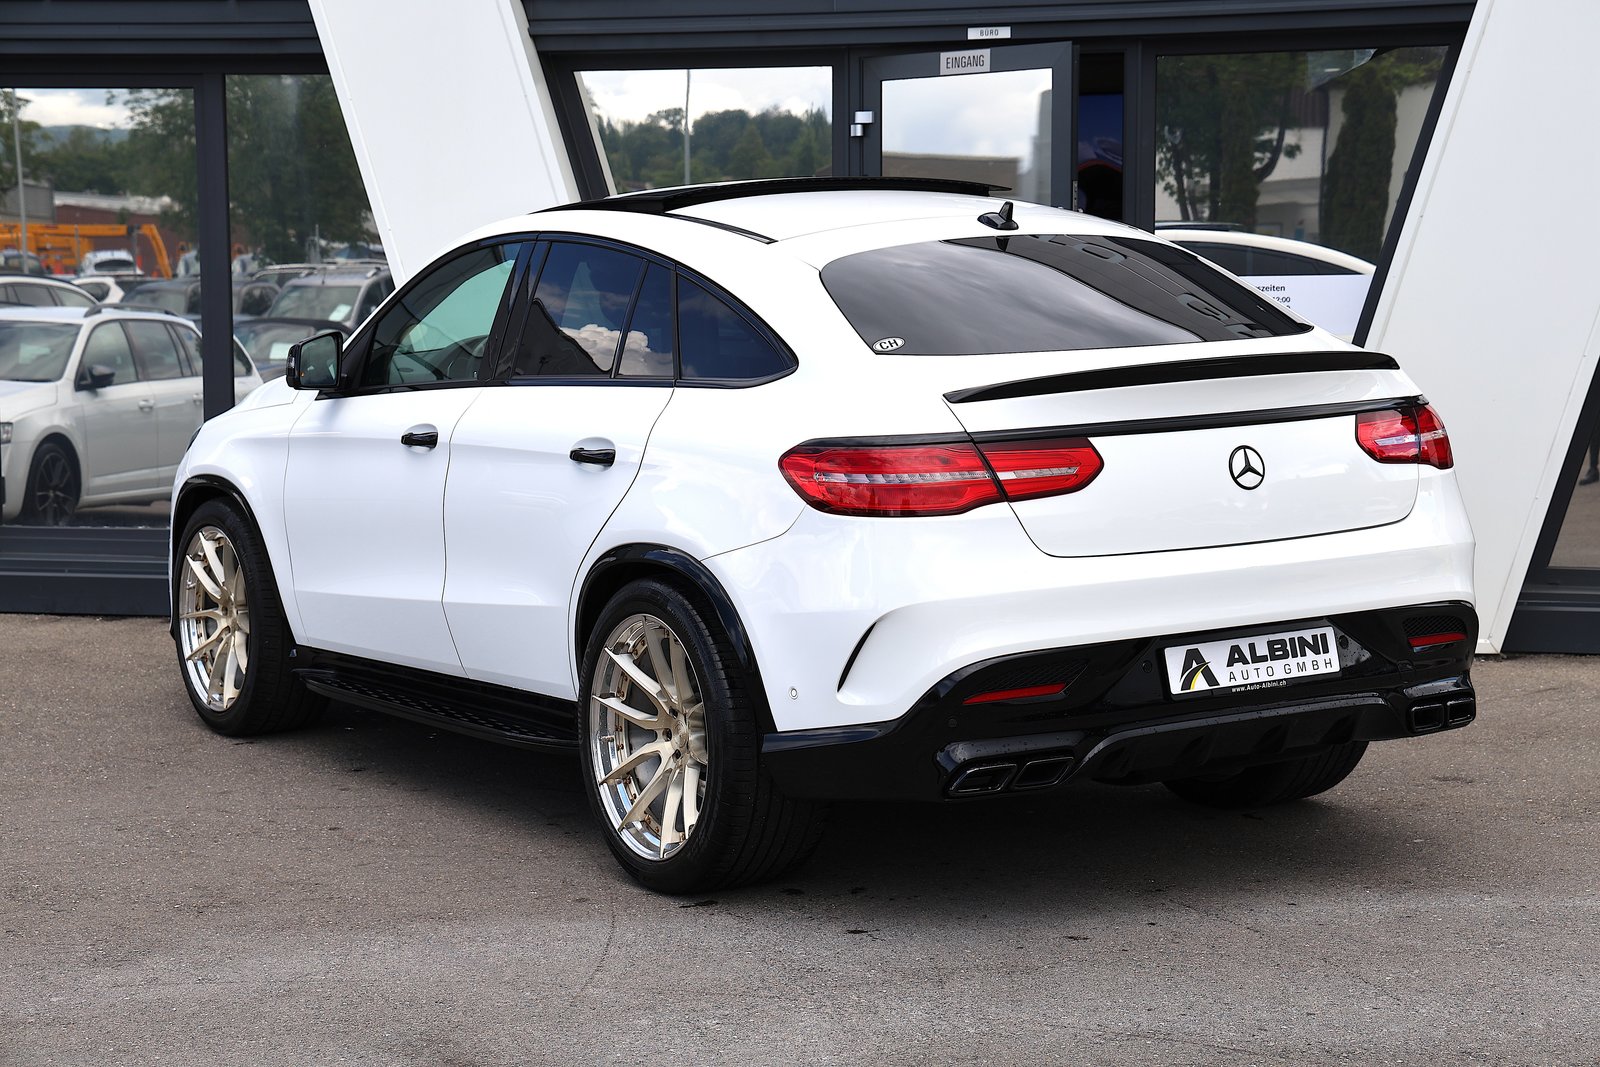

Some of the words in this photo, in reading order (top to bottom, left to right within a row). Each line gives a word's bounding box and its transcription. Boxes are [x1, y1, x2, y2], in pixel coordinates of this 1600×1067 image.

[979, 29, 999, 37] BÜRO
[945, 54, 985, 69] EINGANG
[879, 339, 899, 350] CH
[1226, 632, 1330, 668] ALBINI
[1228, 665, 1275, 683] AUTO
[1283, 657, 1333, 675] GMBH
[1231, 680, 1287, 693] www.Auto-Albini.ch
